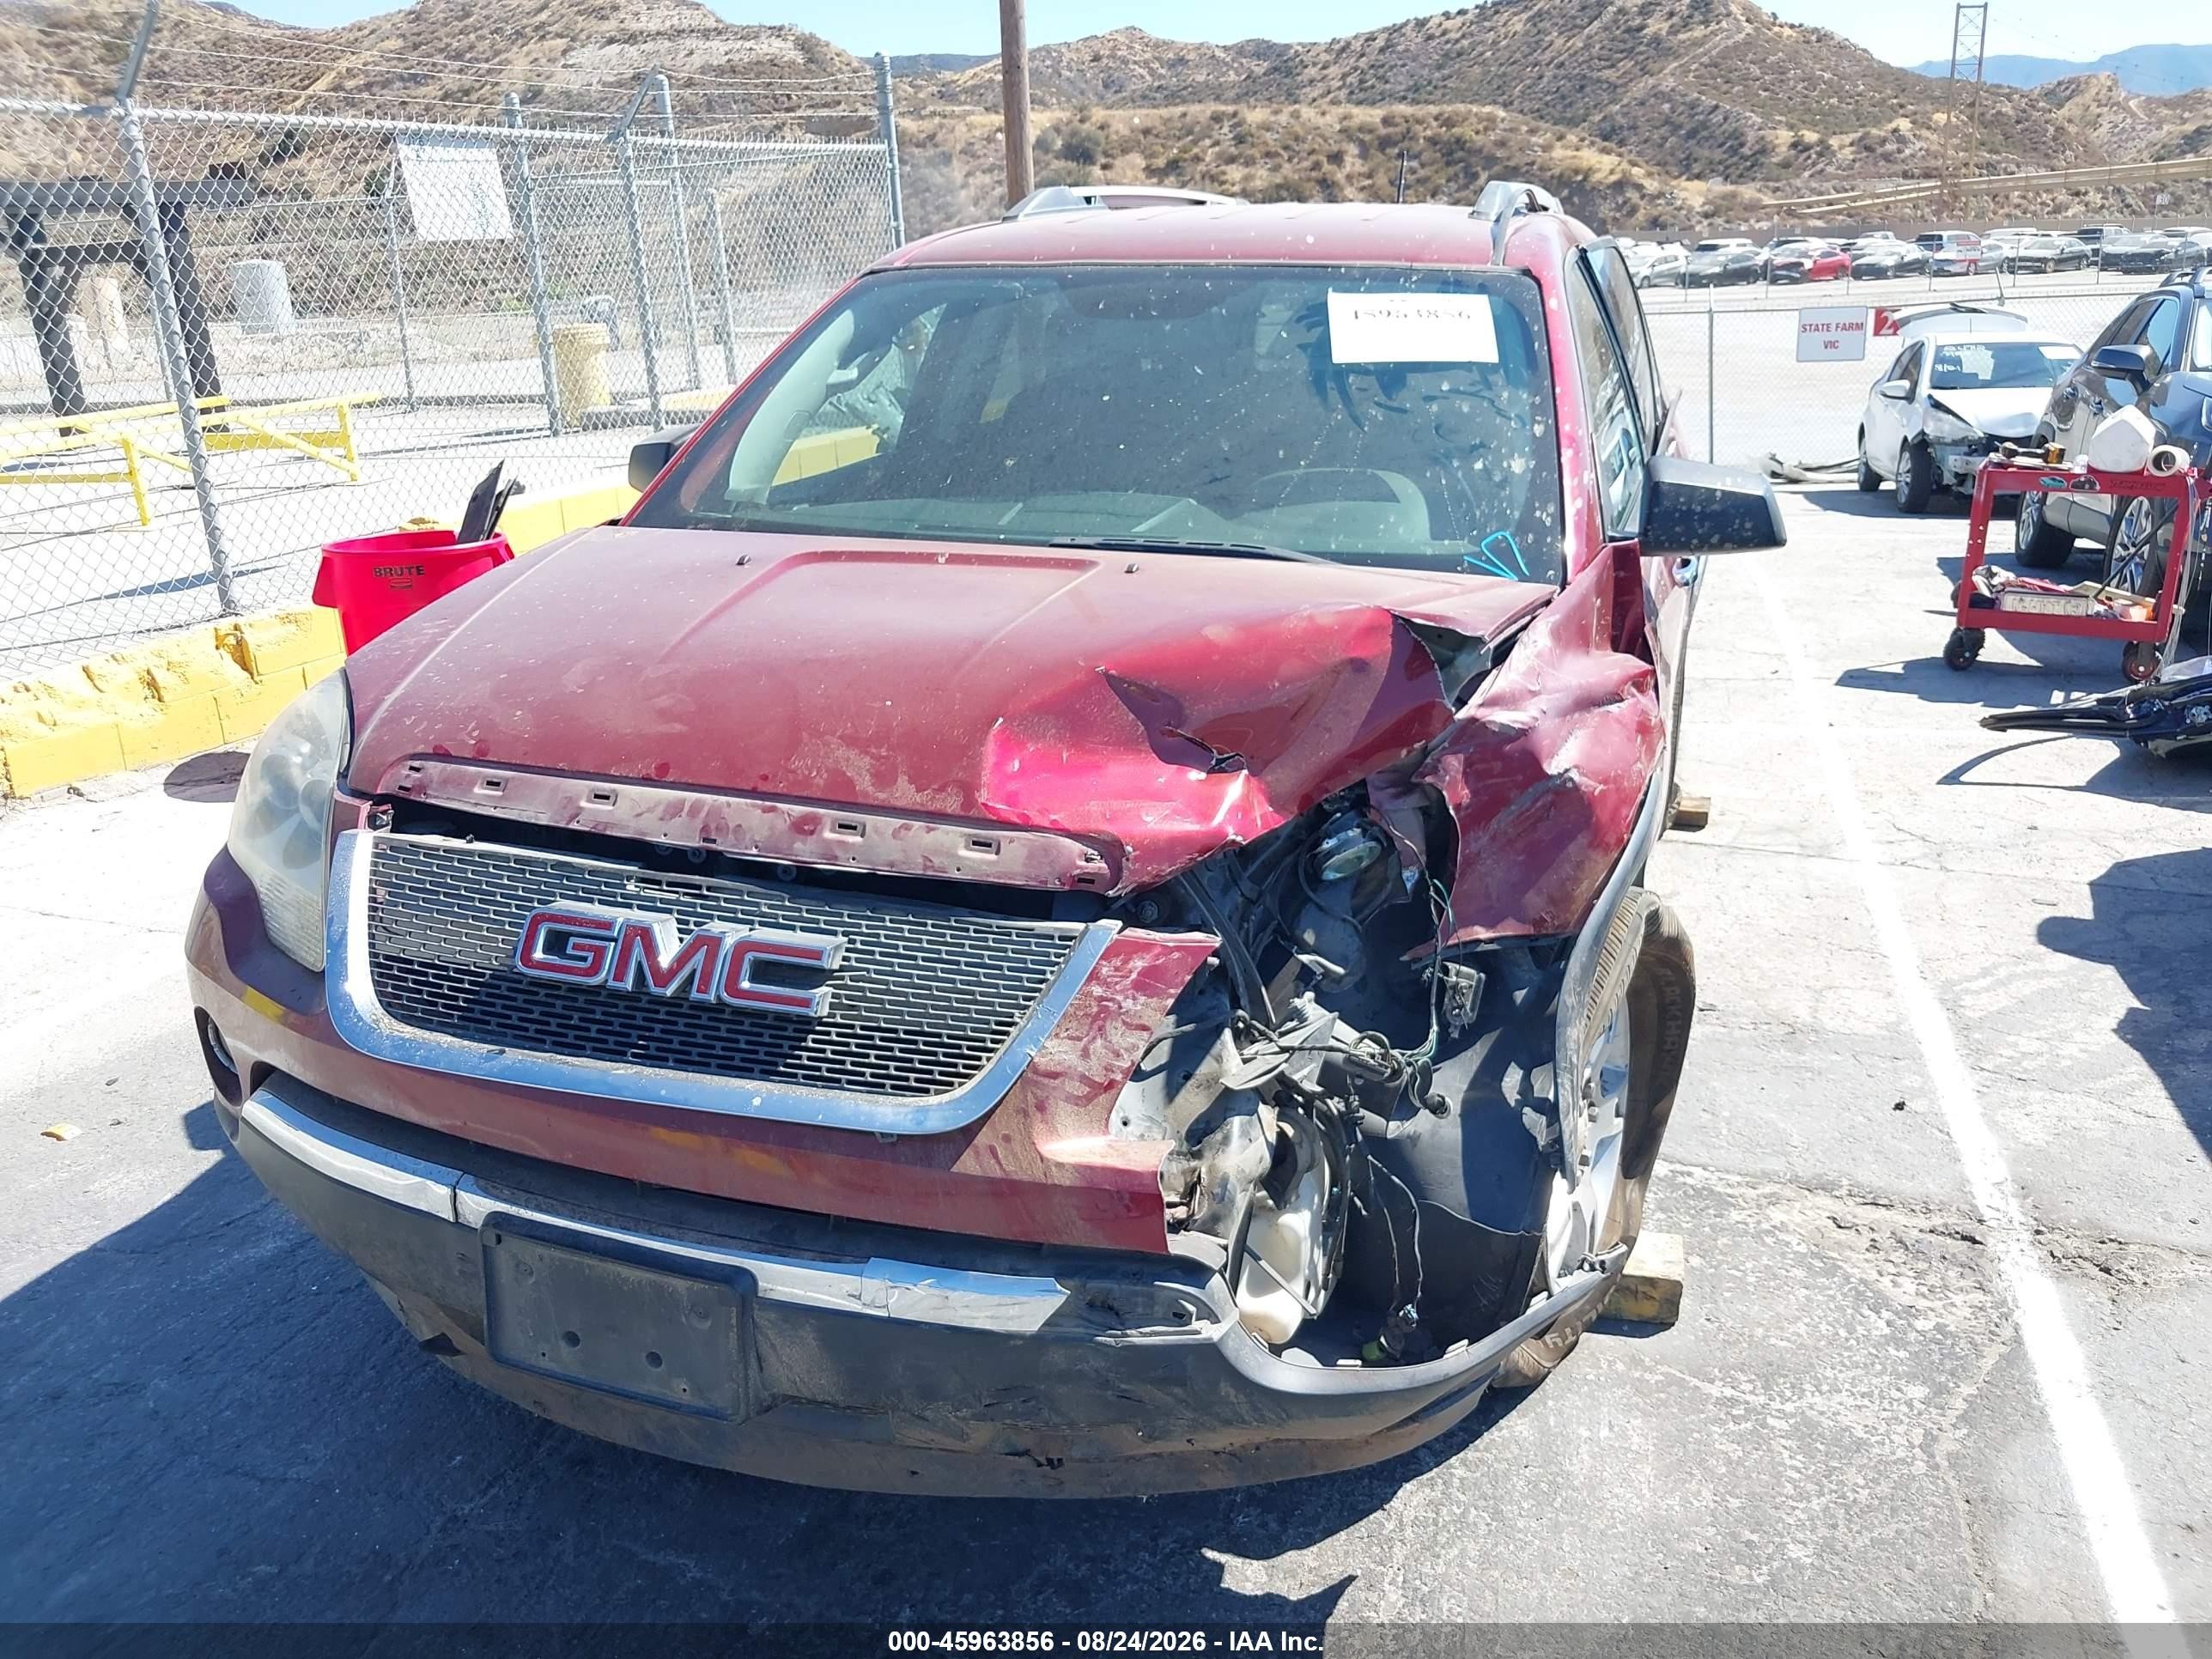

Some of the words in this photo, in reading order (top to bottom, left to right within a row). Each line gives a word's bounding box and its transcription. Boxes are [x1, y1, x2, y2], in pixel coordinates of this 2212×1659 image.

[1801, 323, 1832, 333] STATE
[1834, 322, 1864, 332] FARM
[1823, 340, 1839, 350] VIC
[373, 565, 426, 578] BRUTE
[515, 902, 847, 1018] GMC
